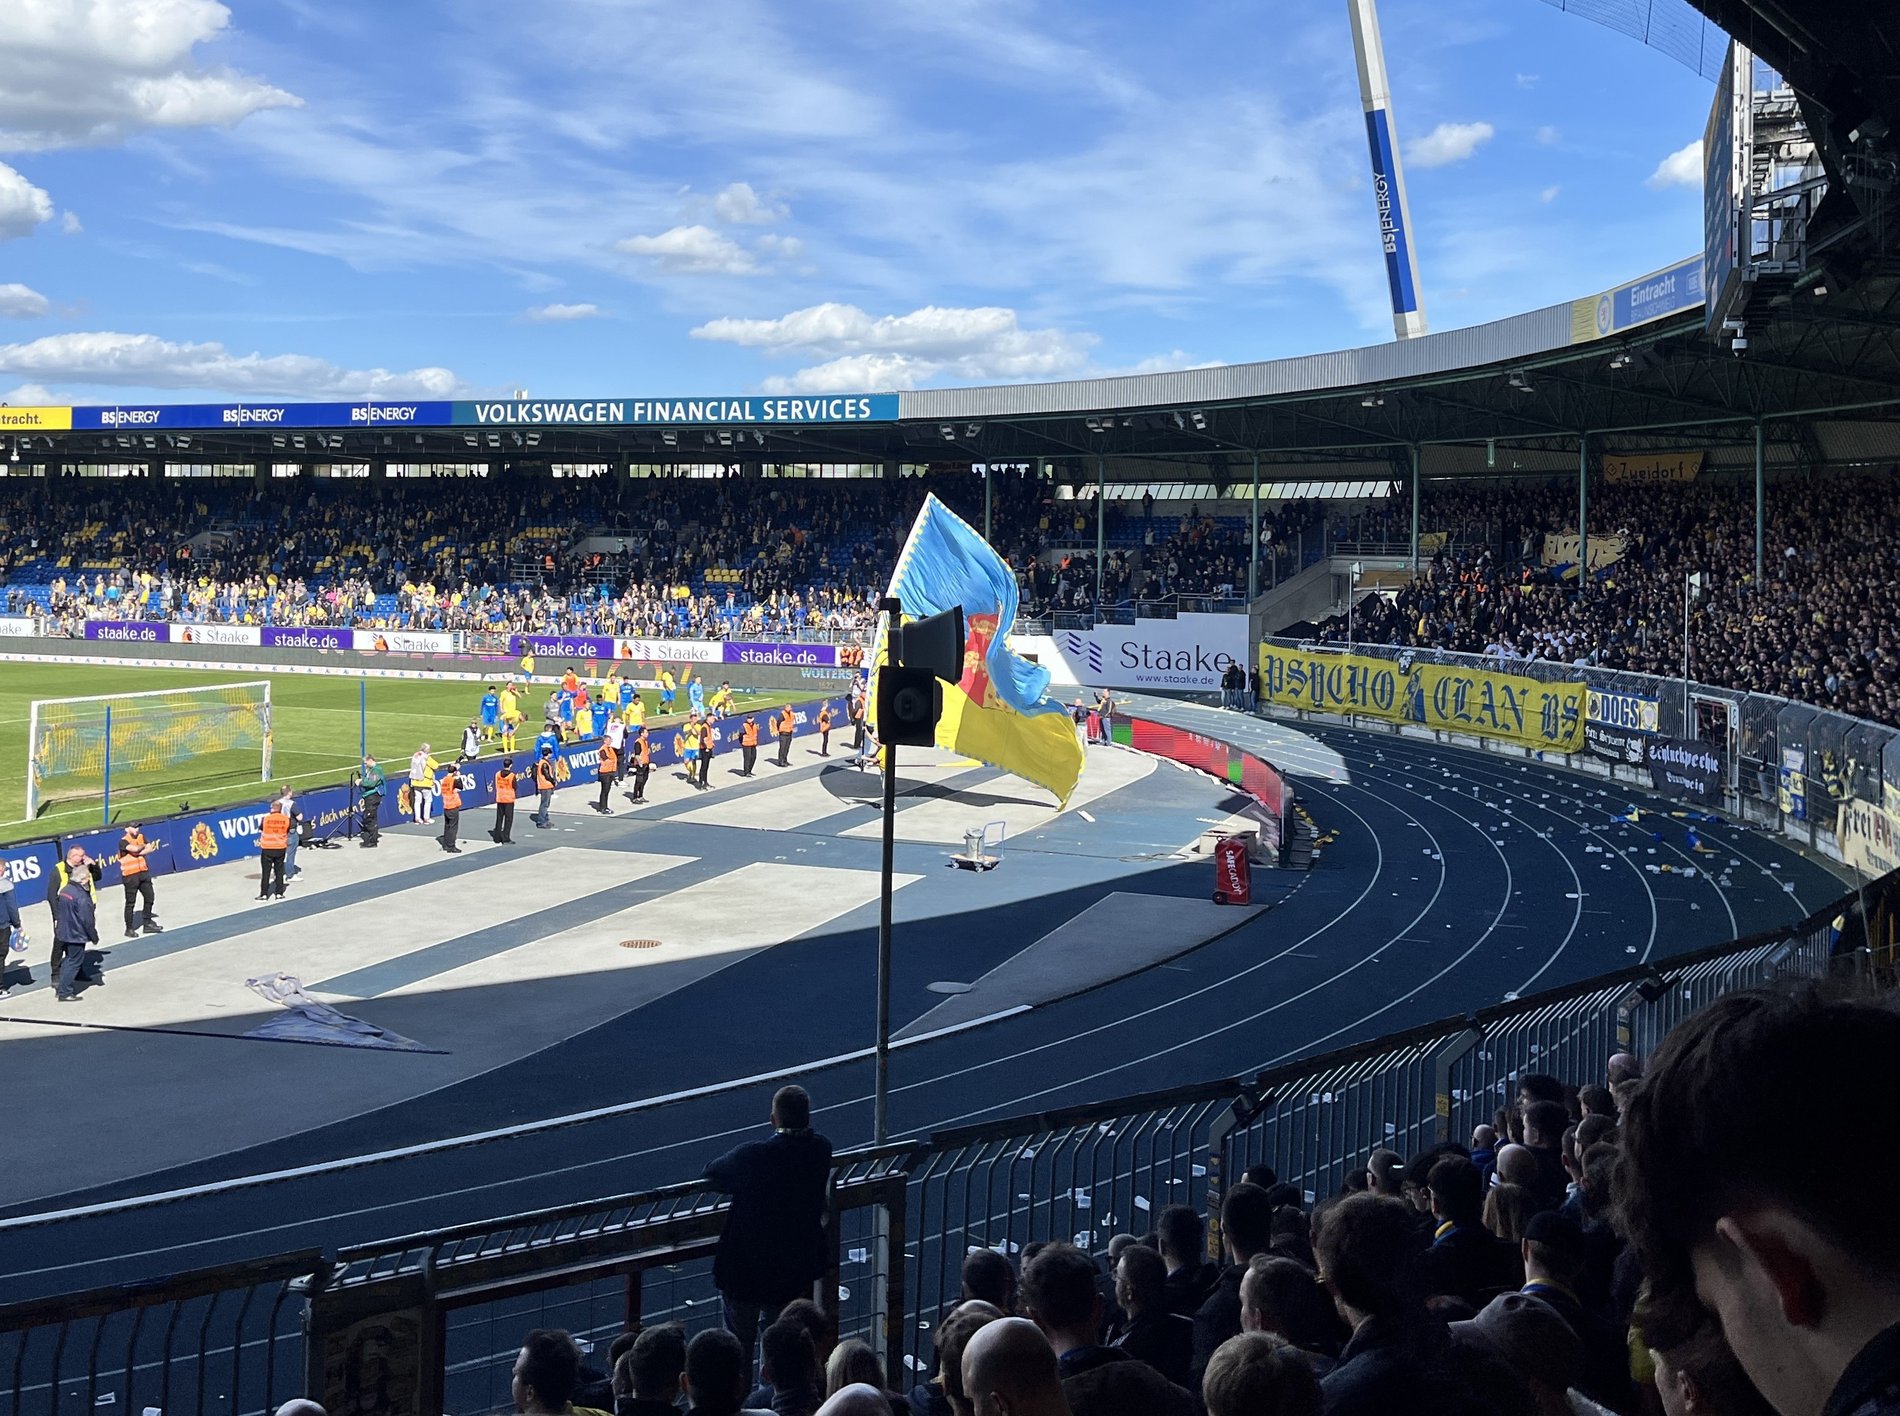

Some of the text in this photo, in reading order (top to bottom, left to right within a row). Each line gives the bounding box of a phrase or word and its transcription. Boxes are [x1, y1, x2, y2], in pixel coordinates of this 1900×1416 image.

[1631, 275, 1676, 307] Eintracht
[0, 412, 42, 425] tracht.
[475, 398, 871, 423] VOLKSWAGEN FINANCIAL SERVICES
[97, 626, 157, 641] staake.de
[206, 629, 250, 644] Staake
[274, 633, 339, 649] staake.de
[393, 636, 439, 651] Staake
[534, 641, 597, 657] taake.de
[657, 644, 709, 661] Staake
[740, 649, 817, 665] staake.de
[1119, 641, 1232, 674] Staake
[800, 667, 853, 680] WOLTERS
[1135, 674, 1215, 686] www.staake.de
[1265, 654, 1580, 742] PSYCHO CLAN BS
[1600, 694, 1640, 728] DOGS
